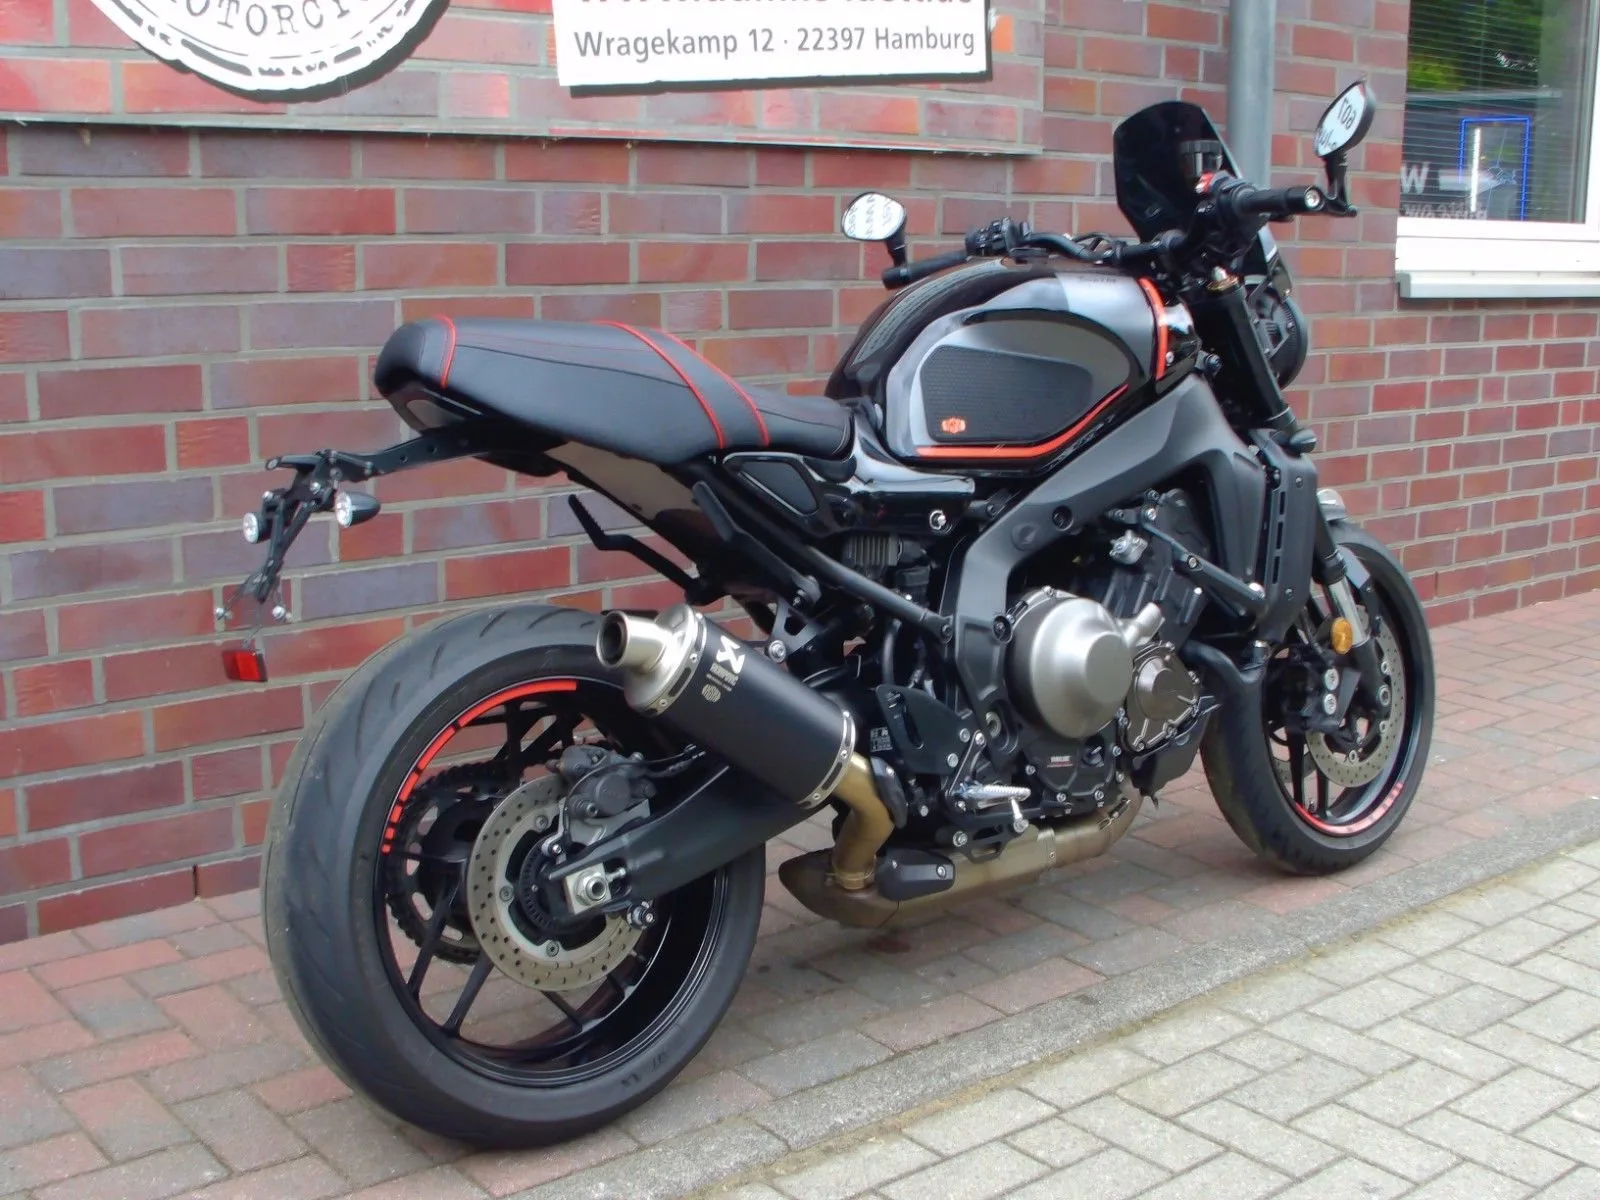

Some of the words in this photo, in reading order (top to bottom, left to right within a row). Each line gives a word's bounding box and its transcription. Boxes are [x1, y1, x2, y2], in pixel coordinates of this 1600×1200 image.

[573, 27, 738, 64] Wragekamp
[748, 27, 775, 53] 12
[797, 27, 865, 52] 22397
[875, 25, 975, 57] Hamburg
